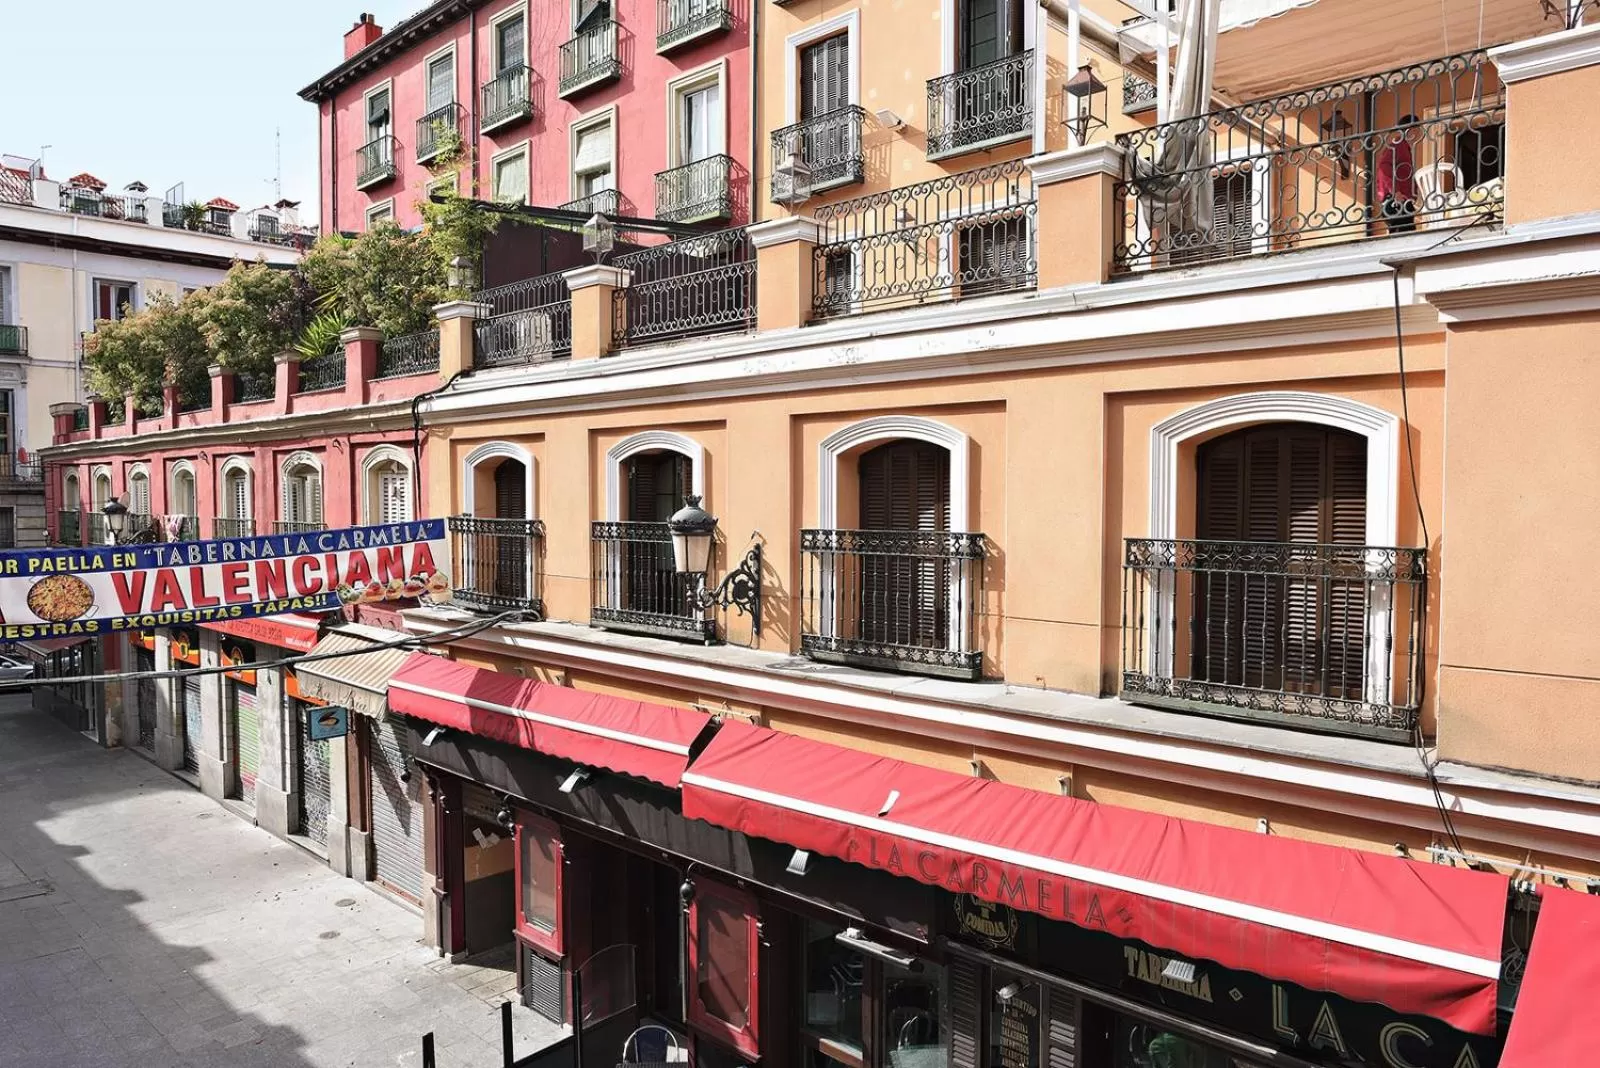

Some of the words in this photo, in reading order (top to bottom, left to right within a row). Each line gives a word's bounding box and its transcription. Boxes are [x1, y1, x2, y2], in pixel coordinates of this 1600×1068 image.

[0, 559, 18, 574] R
[29, 555, 104, 573] PAELLA
[113, 552, 137, 568] EN
[284, 535, 310, 556] LA
[111, 541, 437, 616] VALENCIANA
[0, 620, 99, 639] ESTRAS
[111, 606, 242, 631] EXQUISITAS
[252, 595, 327, 614] TAPAS!!
[870, 836, 904, 873] LA
[918, 850, 1107, 929] CARMELA
[1272, 983, 1347, 1053] LA
